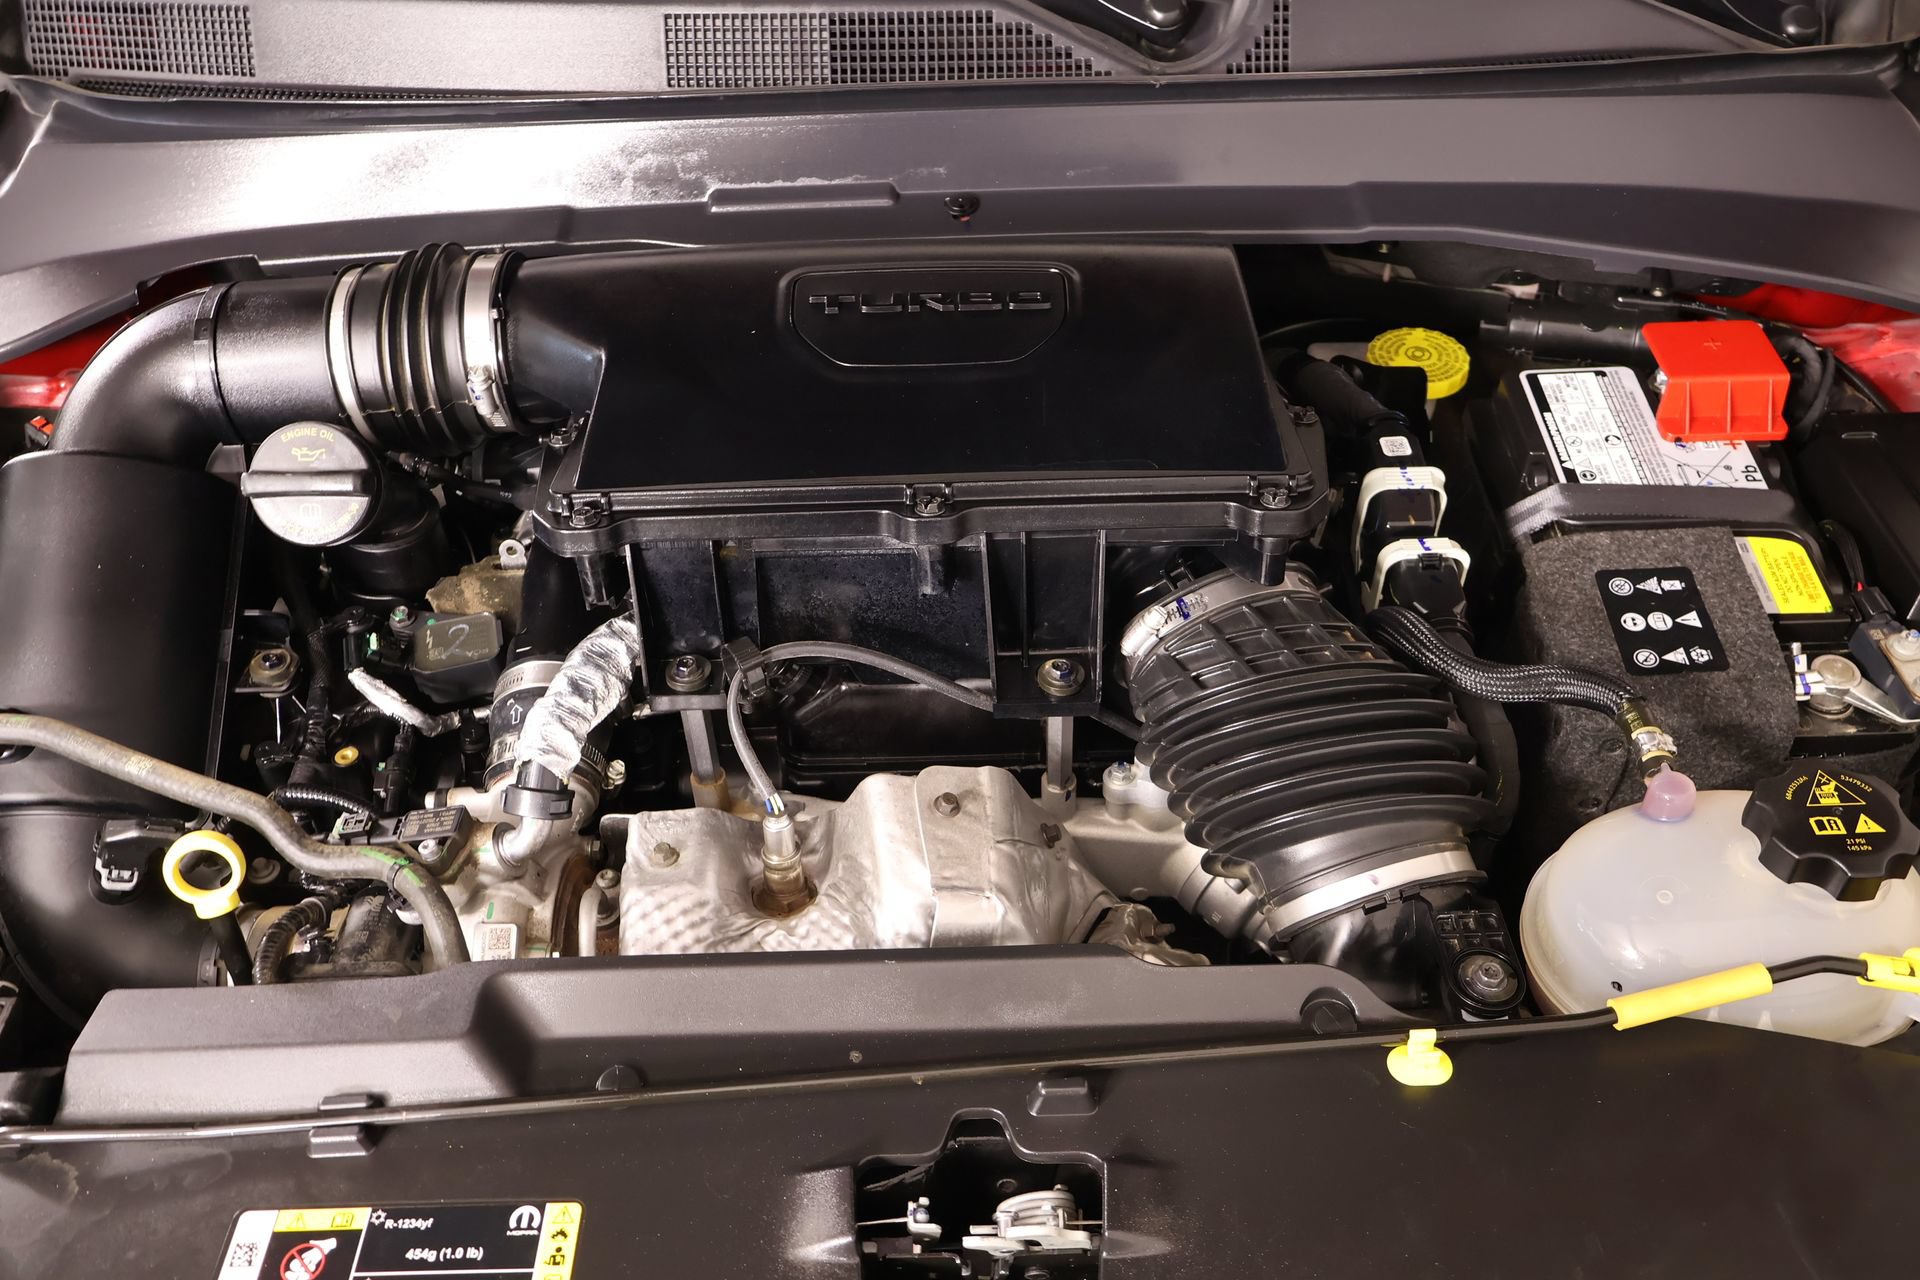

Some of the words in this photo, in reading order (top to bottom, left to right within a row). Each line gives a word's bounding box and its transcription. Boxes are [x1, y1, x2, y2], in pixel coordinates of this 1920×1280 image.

[808, 291, 1051, 314] TURBO
[280, 427, 319, 442] ENGINE
[319, 428, 336, 443] OIL
[1740, 464, 1763, 482] Pb
[384, 1217, 434, 1230] R-1234yf
[404, 1247, 437, 1262] 454g
[439, 1246, 464, 1262] (1.0
[465, 1246, 484, 1261] lb)
